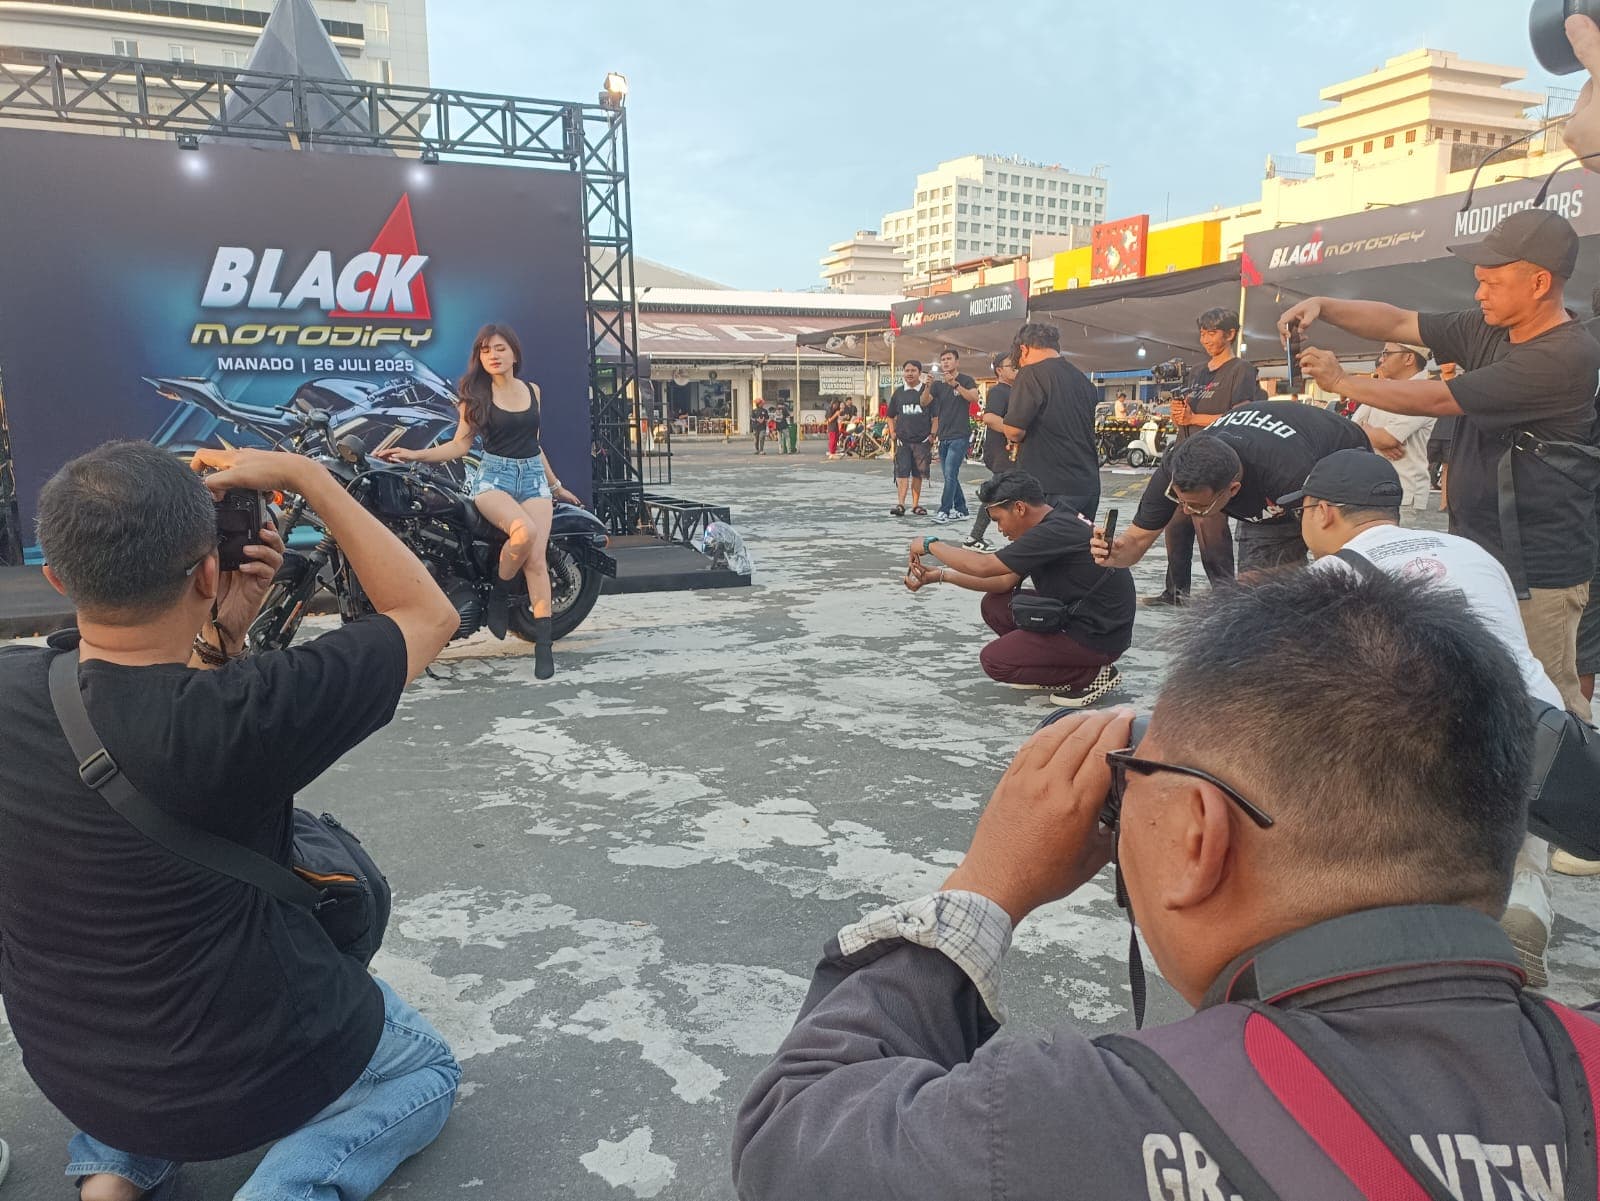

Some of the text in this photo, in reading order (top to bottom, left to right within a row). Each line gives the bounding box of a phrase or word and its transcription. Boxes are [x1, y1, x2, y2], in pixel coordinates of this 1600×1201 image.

[1268, 228, 1426, 269] BLACK MOTODIFY
[200, 246, 429, 313] BLACK
[969, 294, 1012, 316] MODIFICATORS
[901, 311, 924, 327] BLACK
[191, 323, 432, 346] MOTODIFY
[217, 357, 294, 371] MANADO
[313, 358, 334, 372] 26
[338, 358, 371, 372] JULI
[374, 358, 414, 372] 2025
